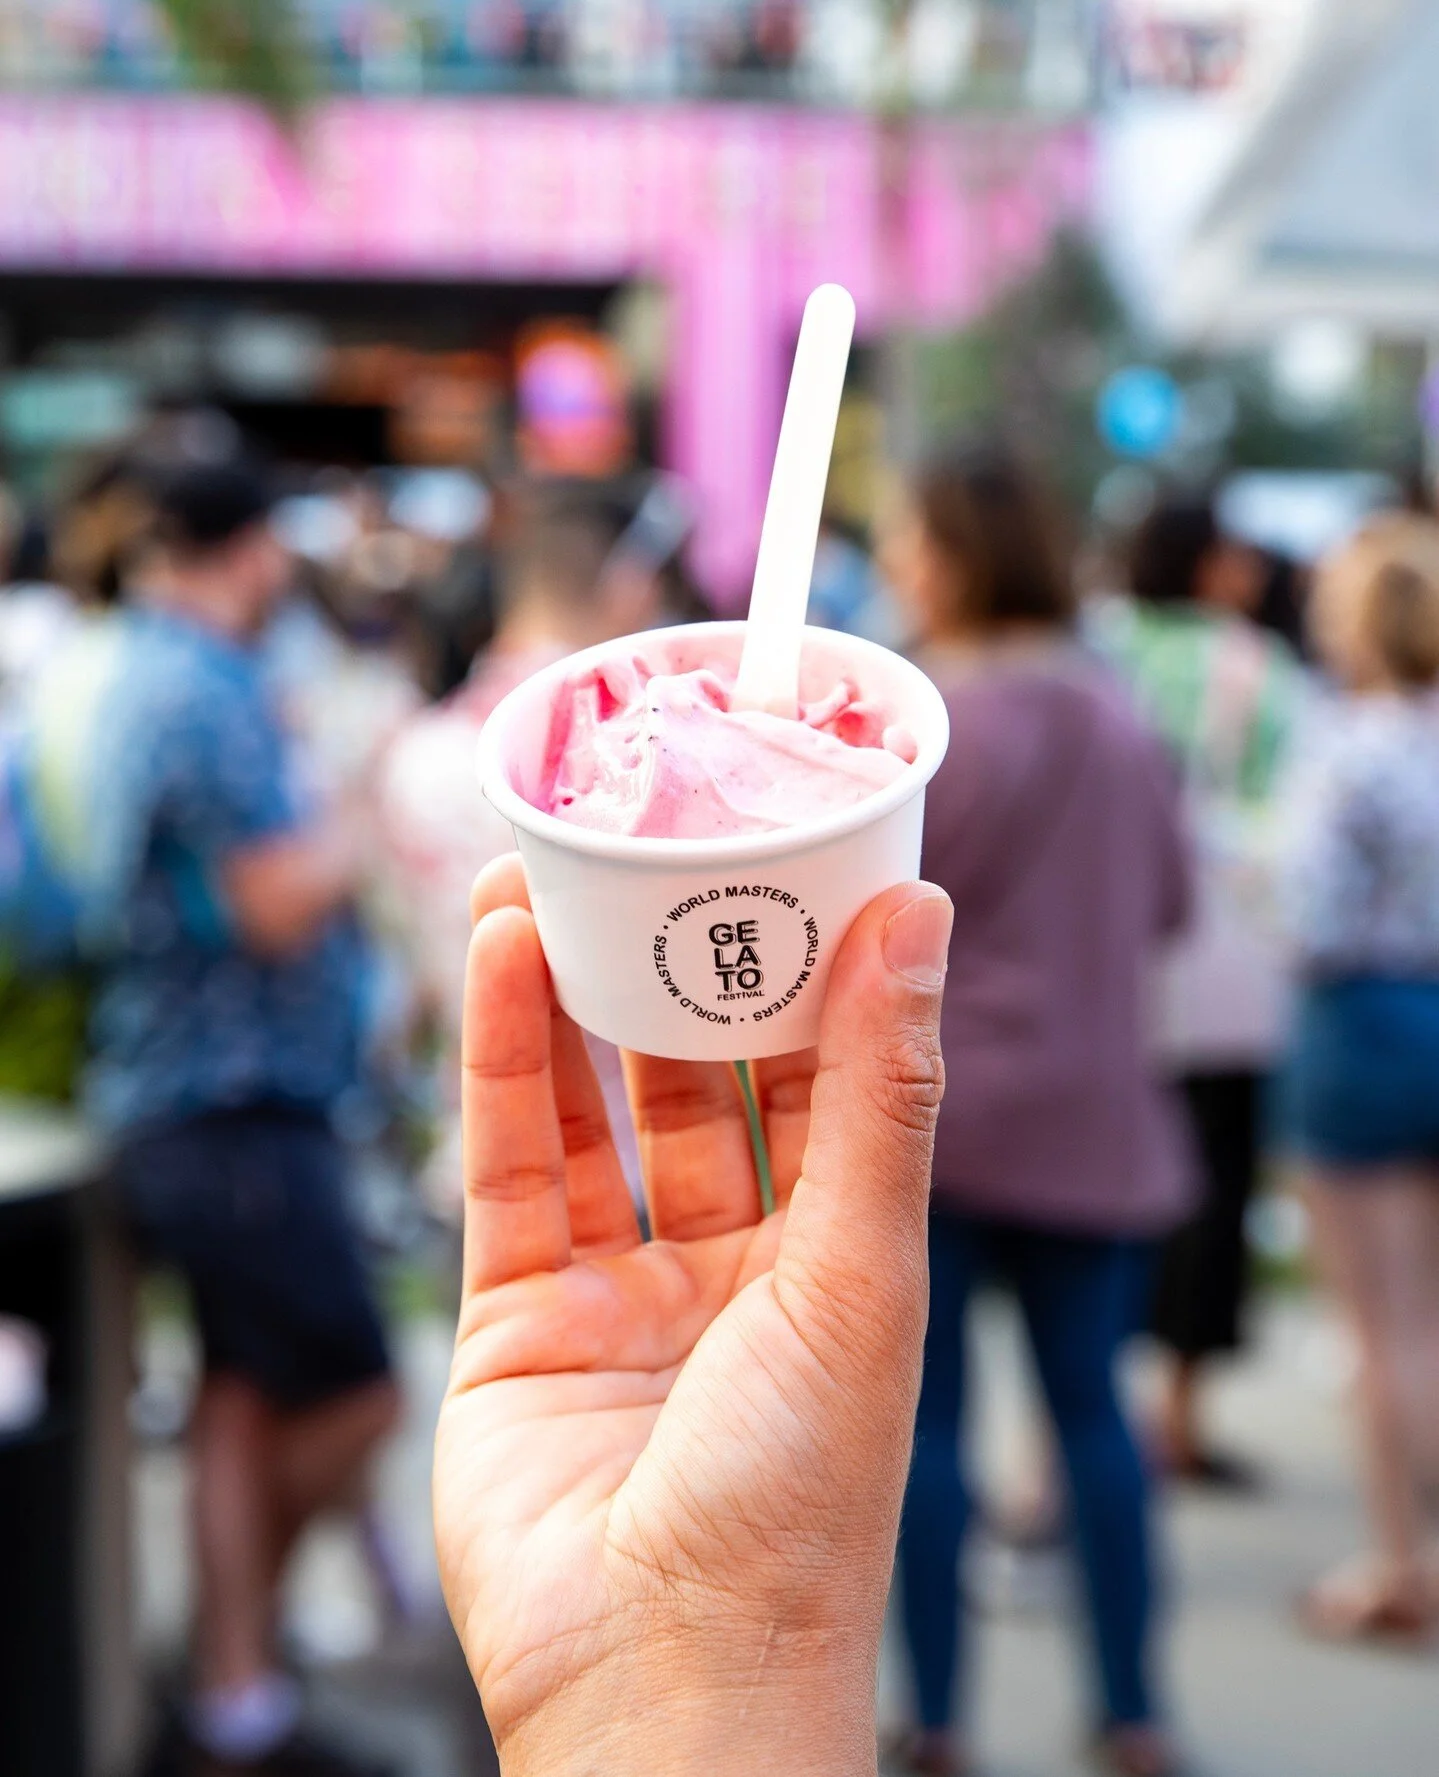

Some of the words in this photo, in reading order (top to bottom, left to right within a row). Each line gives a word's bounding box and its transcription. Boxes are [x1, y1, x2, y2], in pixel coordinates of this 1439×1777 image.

[667, 889, 720, 922] WORLD
[725, 885, 799, 909] MASTERS
[708, 919, 760, 946] GE
[803, 916, 819, 967] WORLD
[653, 935, 682, 998] MASTERS
[714, 945, 761, 969] LA
[714, 967, 764, 992] TO
[717, 990, 765, 1001] FESTIVAL
[752, 970, 811, 1022] MASTERS
[679, 997, 731, 1025] WORLD
